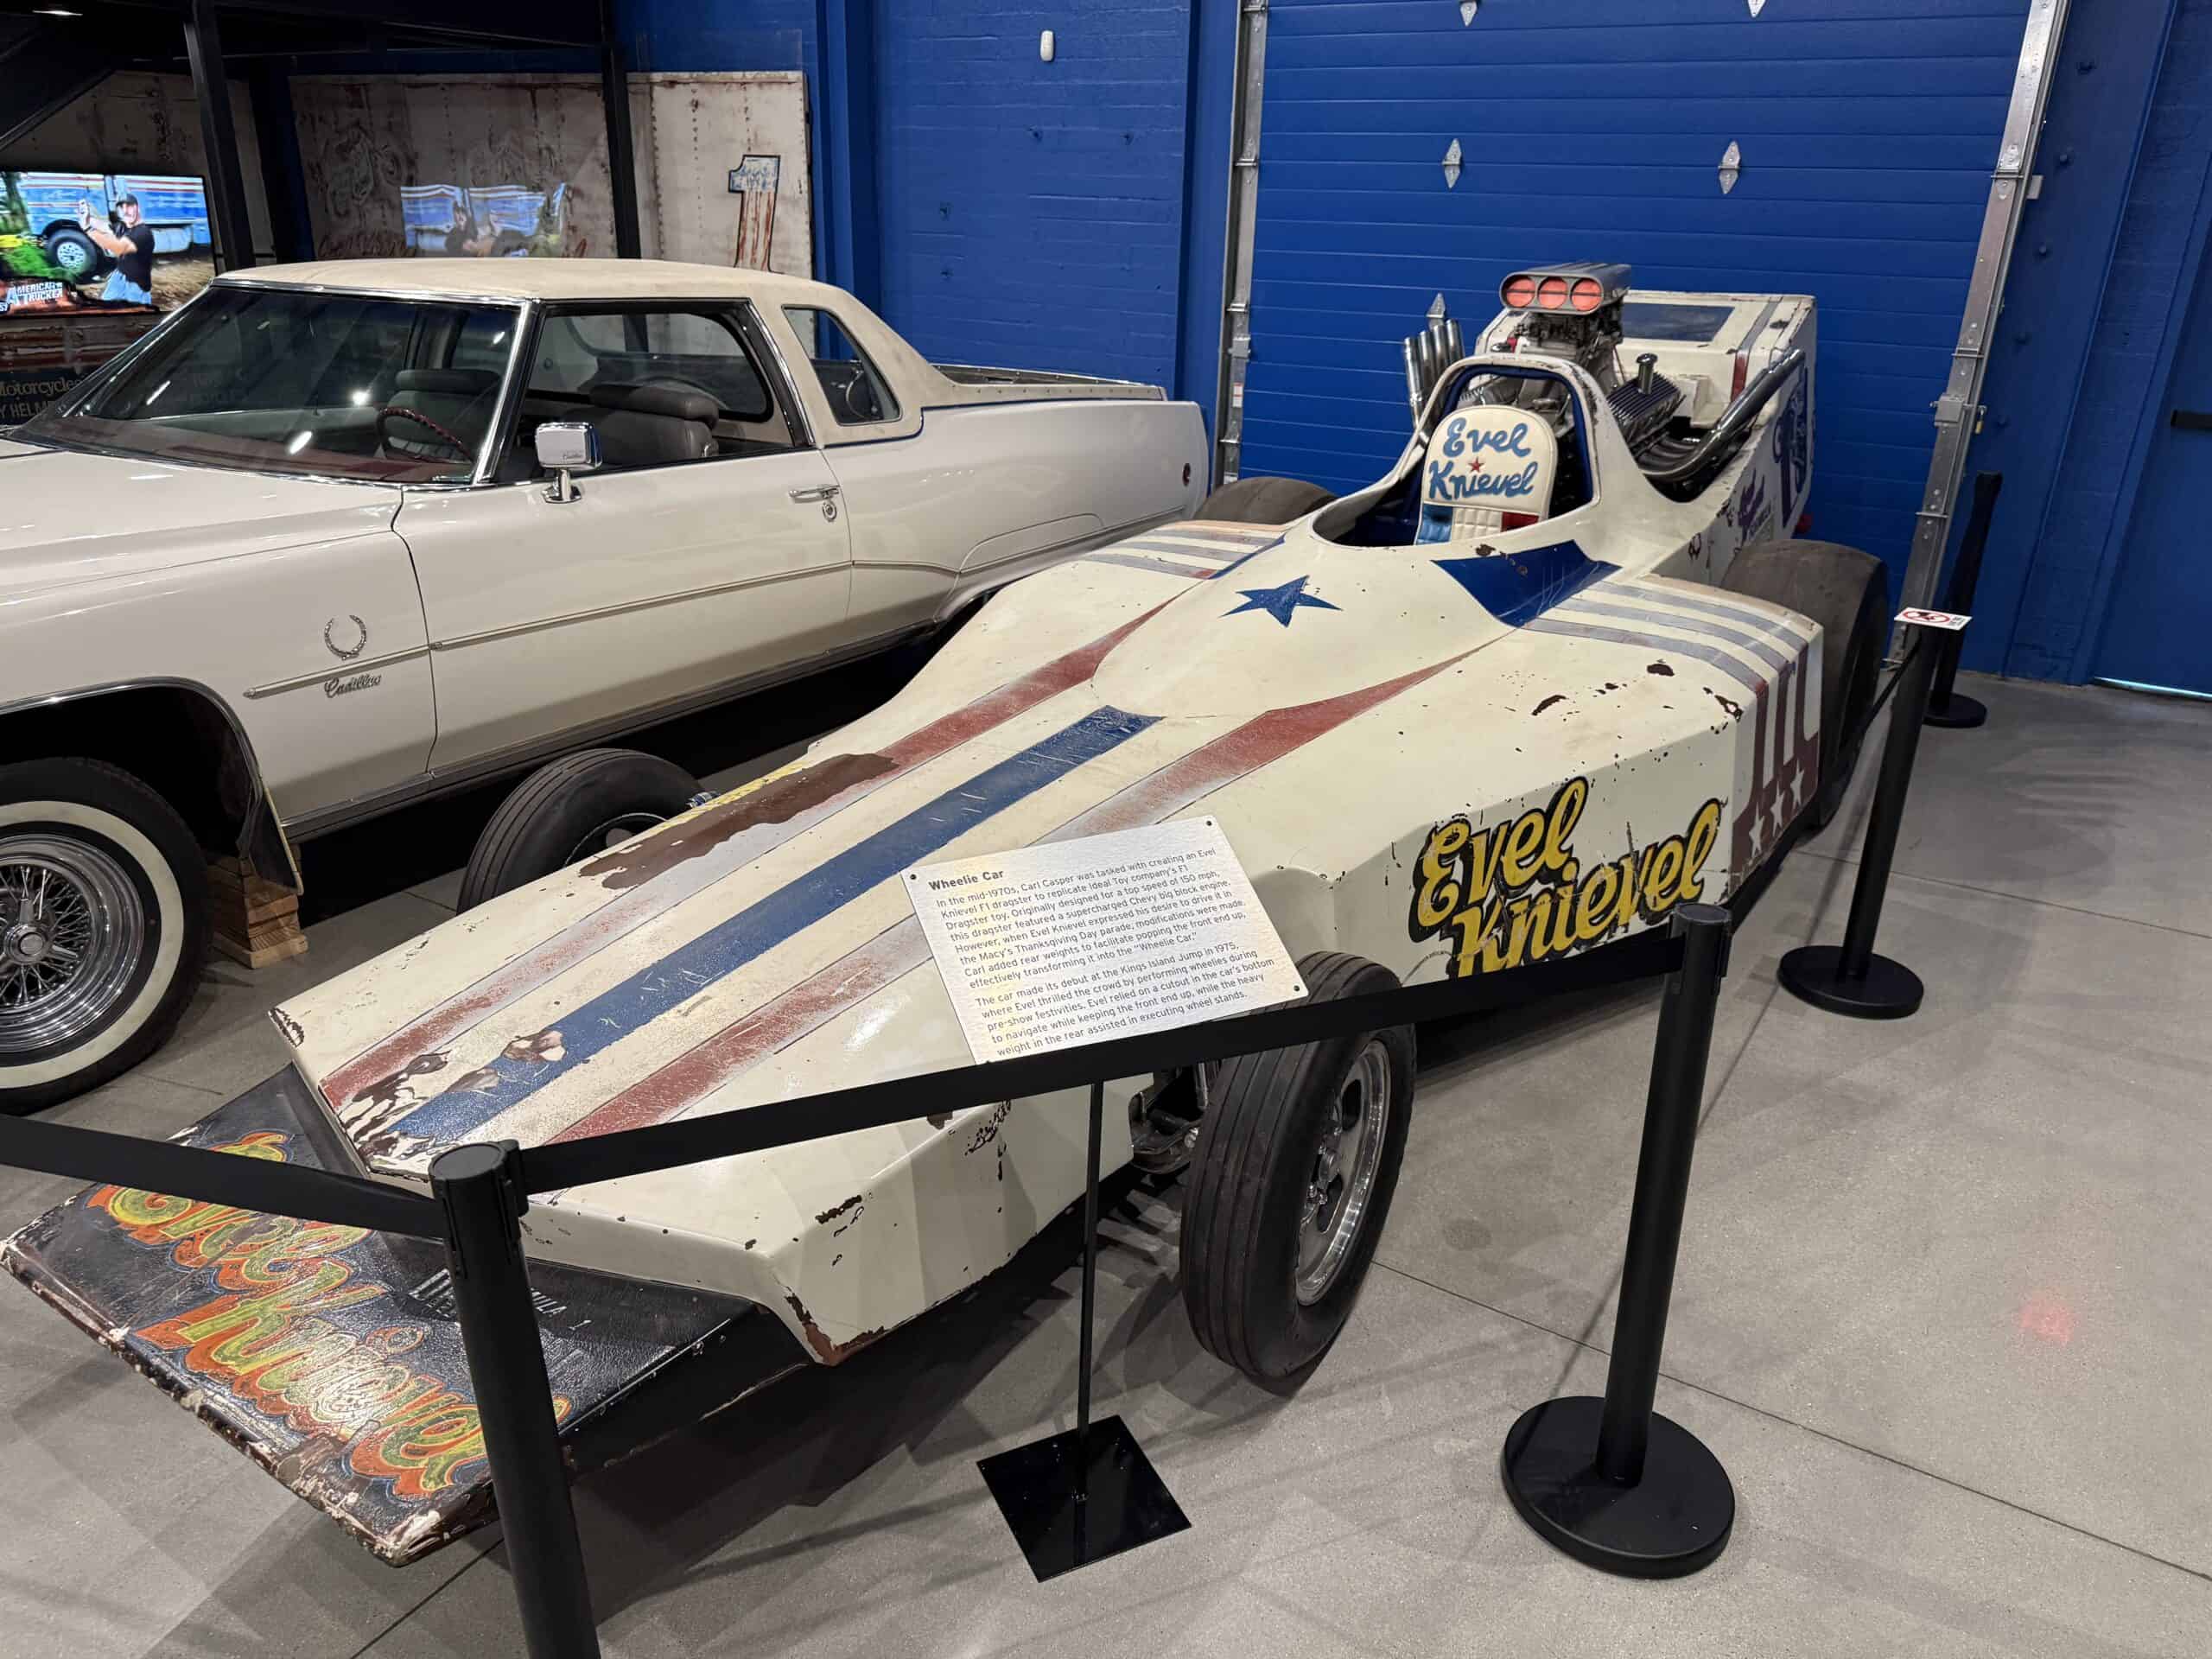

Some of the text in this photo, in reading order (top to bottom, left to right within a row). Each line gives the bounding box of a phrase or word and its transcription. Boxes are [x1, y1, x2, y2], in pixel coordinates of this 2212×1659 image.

[1443, 417, 1531, 458] Evel
[1428, 459, 1538, 500] Knievel
[324, 675, 382, 698] Cadillac
[929, 871, 1004, 890] Wheelie Car
[948, 896, 964, 905] the
[1020, 881, 1039, 891] Carl
[1041, 876, 1074, 887] Casper
[1096, 865, 1126, 876] tasked
[1128, 861, 1147, 870] with
[1148, 855, 1184, 866] creating
[1198, 848, 1215, 856] Evel
[1410, 777, 1588, 940] Evel
[941, 905, 976, 918] Knievel
[991, 895, 1032, 907] dragster
[1047, 885, 1086, 897] replicate
[1089, 879, 1110, 889] Ideal
[945, 917, 988, 929] Dragster
[1010, 903, 1056, 916] Originally
[1058, 893, 1099, 907] designed
[1141, 880, 1167, 891] speed
[1180, 874, 1196, 883] 150
[950, 931, 969, 940] this
[971, 924, 1012, 936] dragster
[1014, 913, 1055, 927] featured
[1066, 899, 1128, 918] supercharged
[1128, 895, 1157, 905] Chevy
[1174, 886, 1198, 896] block
[1445, 798, 1721, 978] Knievel
[960, 955, 976, 963] the
[1016, 935, 1077, 951] Thanksgiving
[1135, 910, 1194, 927] modifications
[1196, 906, 1217, 914] were
[963, 965, 985, 976] Carl
[988, 958, 1017, 970] added
[1020, 955, 1039, 963] rear
[1043, 947, 1079, 959] weights
[1093, 936, 1134, 948] facilitate
[1136, 927, 1173, 941] popping
[1190, 918, 1211, 928] front
[1214, 914, 1230, 923] end
[1002, 932, 1027, 942] when
[1030, 926, 1050, 937] Evel
[1052, 919, 1085, 932] Knievel
[1088, 910, 1134, 925] expressed
[1150, 902, 1178, 912] desire
[1191, 895, 1212, 904] drive
[969, 971, 1021, 987] effectively
[1023, 957, 1085, 976] transforming
[1096, 951, 1115, 960] into
[1116, 947, 1132, 956] the
[976, 996, 995, 1005] The
[1016, 986, 1043, 996] made
[1060, 976, 1088, 987] debut
[1120, 963, 1147, 974] Kings
[1148, 956, 1175, 968] Island
[1177, 951, 1204, 961] Jump
[982, 1006, 1012, 1018] where
[1014, 1000, 1035, 1010] Evel
[1038, 991, 1072, 1005] thrilled
[1074, 988, 1090, 997] the
[1092, 981, 1121, 993] crowd
[1137, 967, 1188, 984] performing
[1190, 958, 1227, 971] wheelies
[1229, 951, 1258, 963] during
[987, 1014, 1033, 1031] pre-show
[1087, 996, 1107, 1007] Evel
[1109, 989, 1135, 1001] relied
[1160, 978, 1189, 990] cutout
[1202, 972, 1217, 981] the
[1242, 959, 1274, 971] bottom
[1006, 1025, 1047, 1039] navigate
[1051, 1018, 1075, 1028] while
[1077, 1008, 1116, 1022] keeping
[1116, 1004, 1133, 1013] the
[1135, 998, 1158, 1008] front
[1160, 993, 1178, 1003] end
[1196, 984, 1219, 995] while
[1237, 974, 1265, 985] heavy
[997, 1041, 1030, 1054] weight
[1045, 1034, 1061, 1043] the
[1064, 1029, 1084, 1039] rear
[1087, 1018, 1126, 1033] assisted
[1140, 1006, 1185, 1021] executing
[1186, 998, 1212, 1010] wheel
